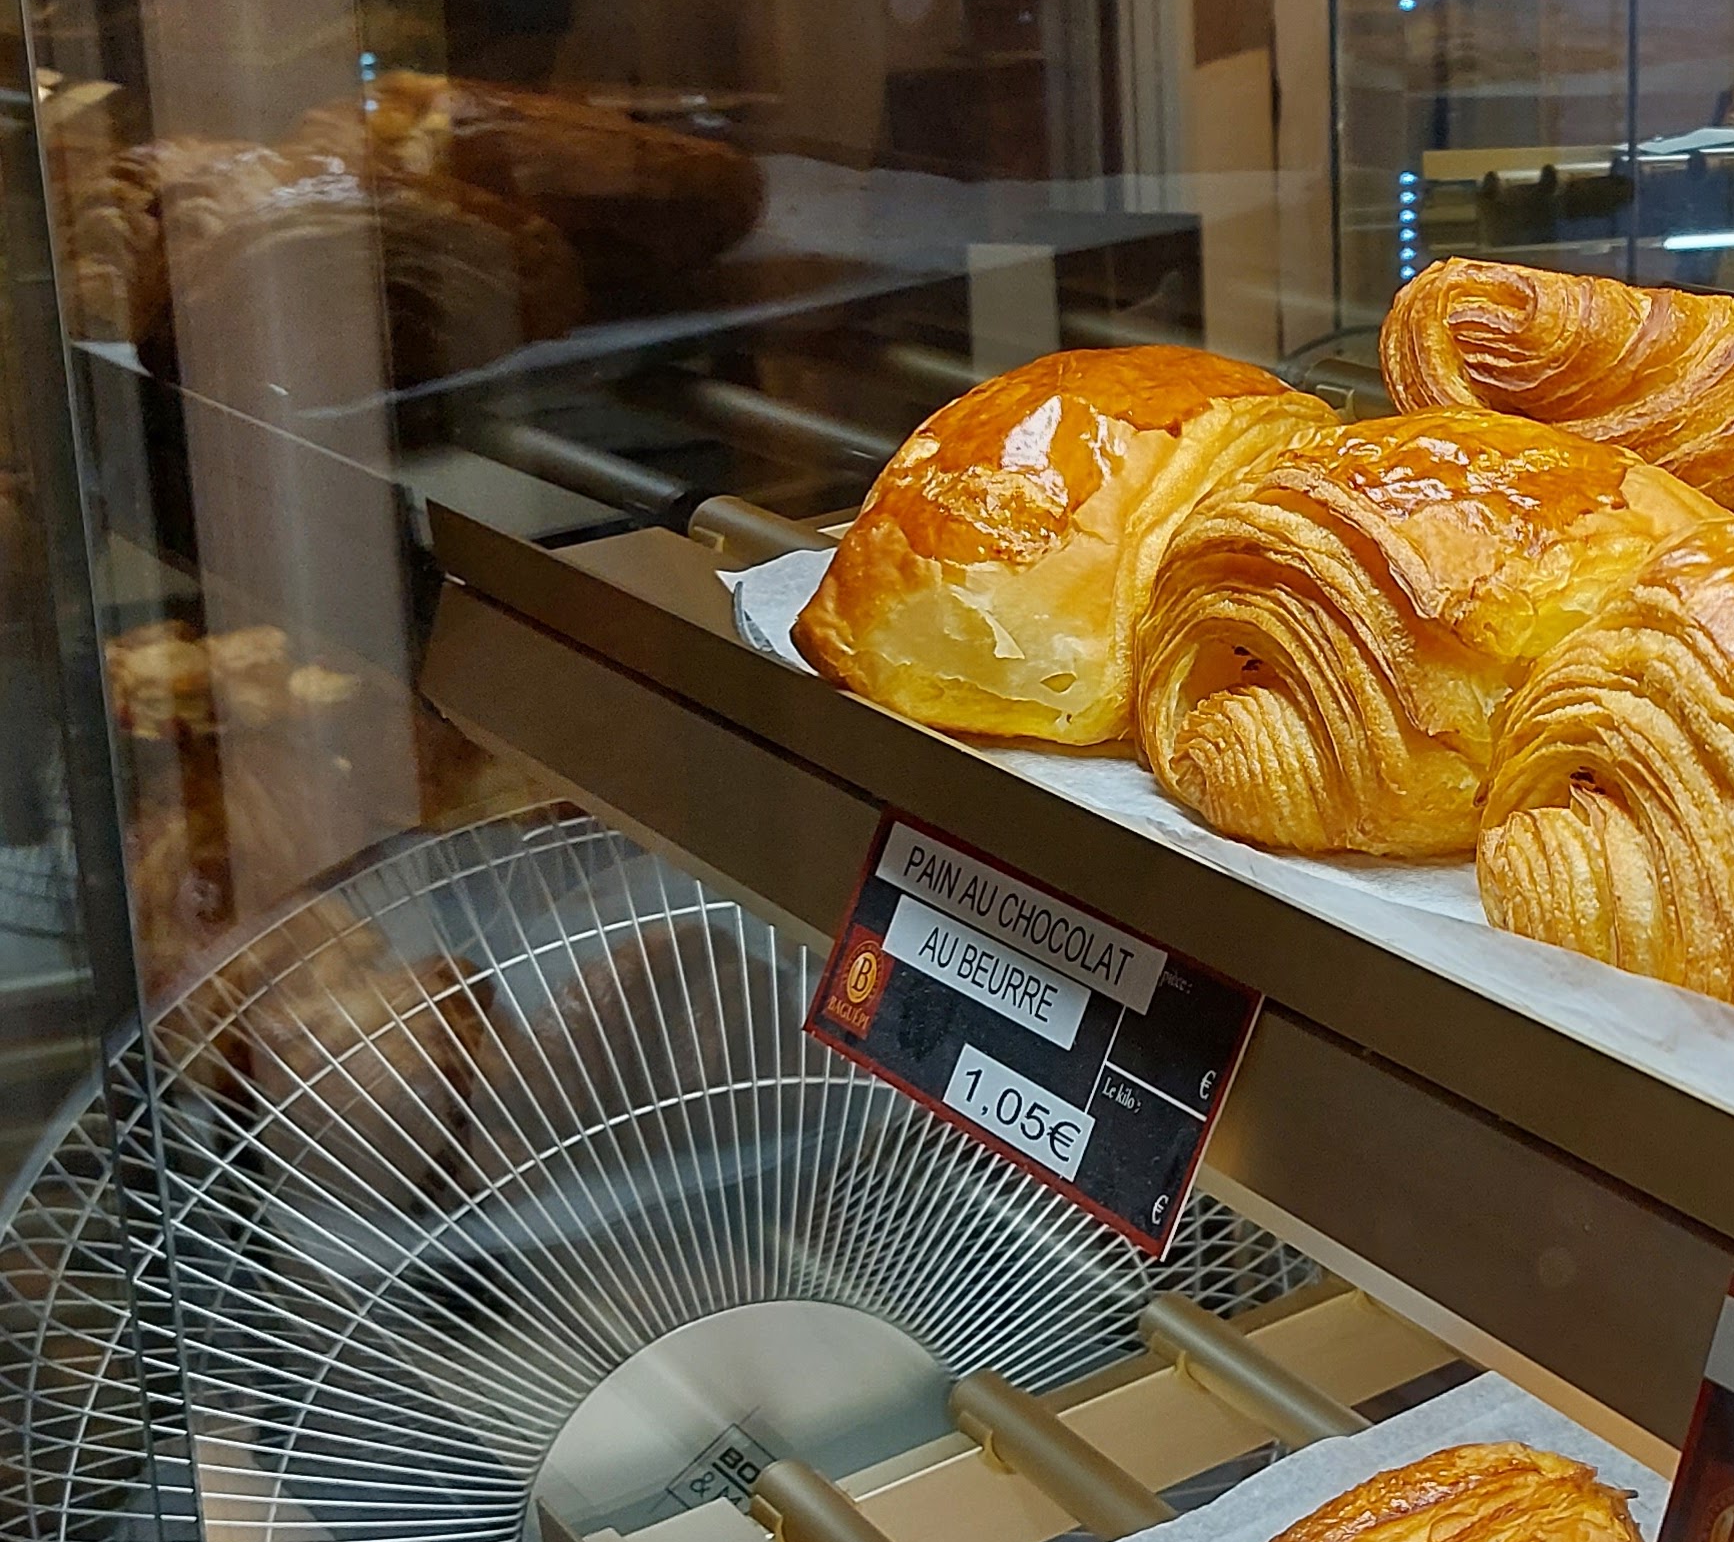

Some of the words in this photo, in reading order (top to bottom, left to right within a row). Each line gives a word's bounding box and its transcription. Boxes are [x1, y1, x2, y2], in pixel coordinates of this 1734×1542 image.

[902, 844, 959, 898] PAIN
[957, 874, 998, 917] AU
[997, 892, 1135, 987] CHOCOLAT
[918, 926, 959, 969] AU
[957, 946, 1059, 1024] BEURRE
[963, 1067, 1082, 1163] 1,05€
